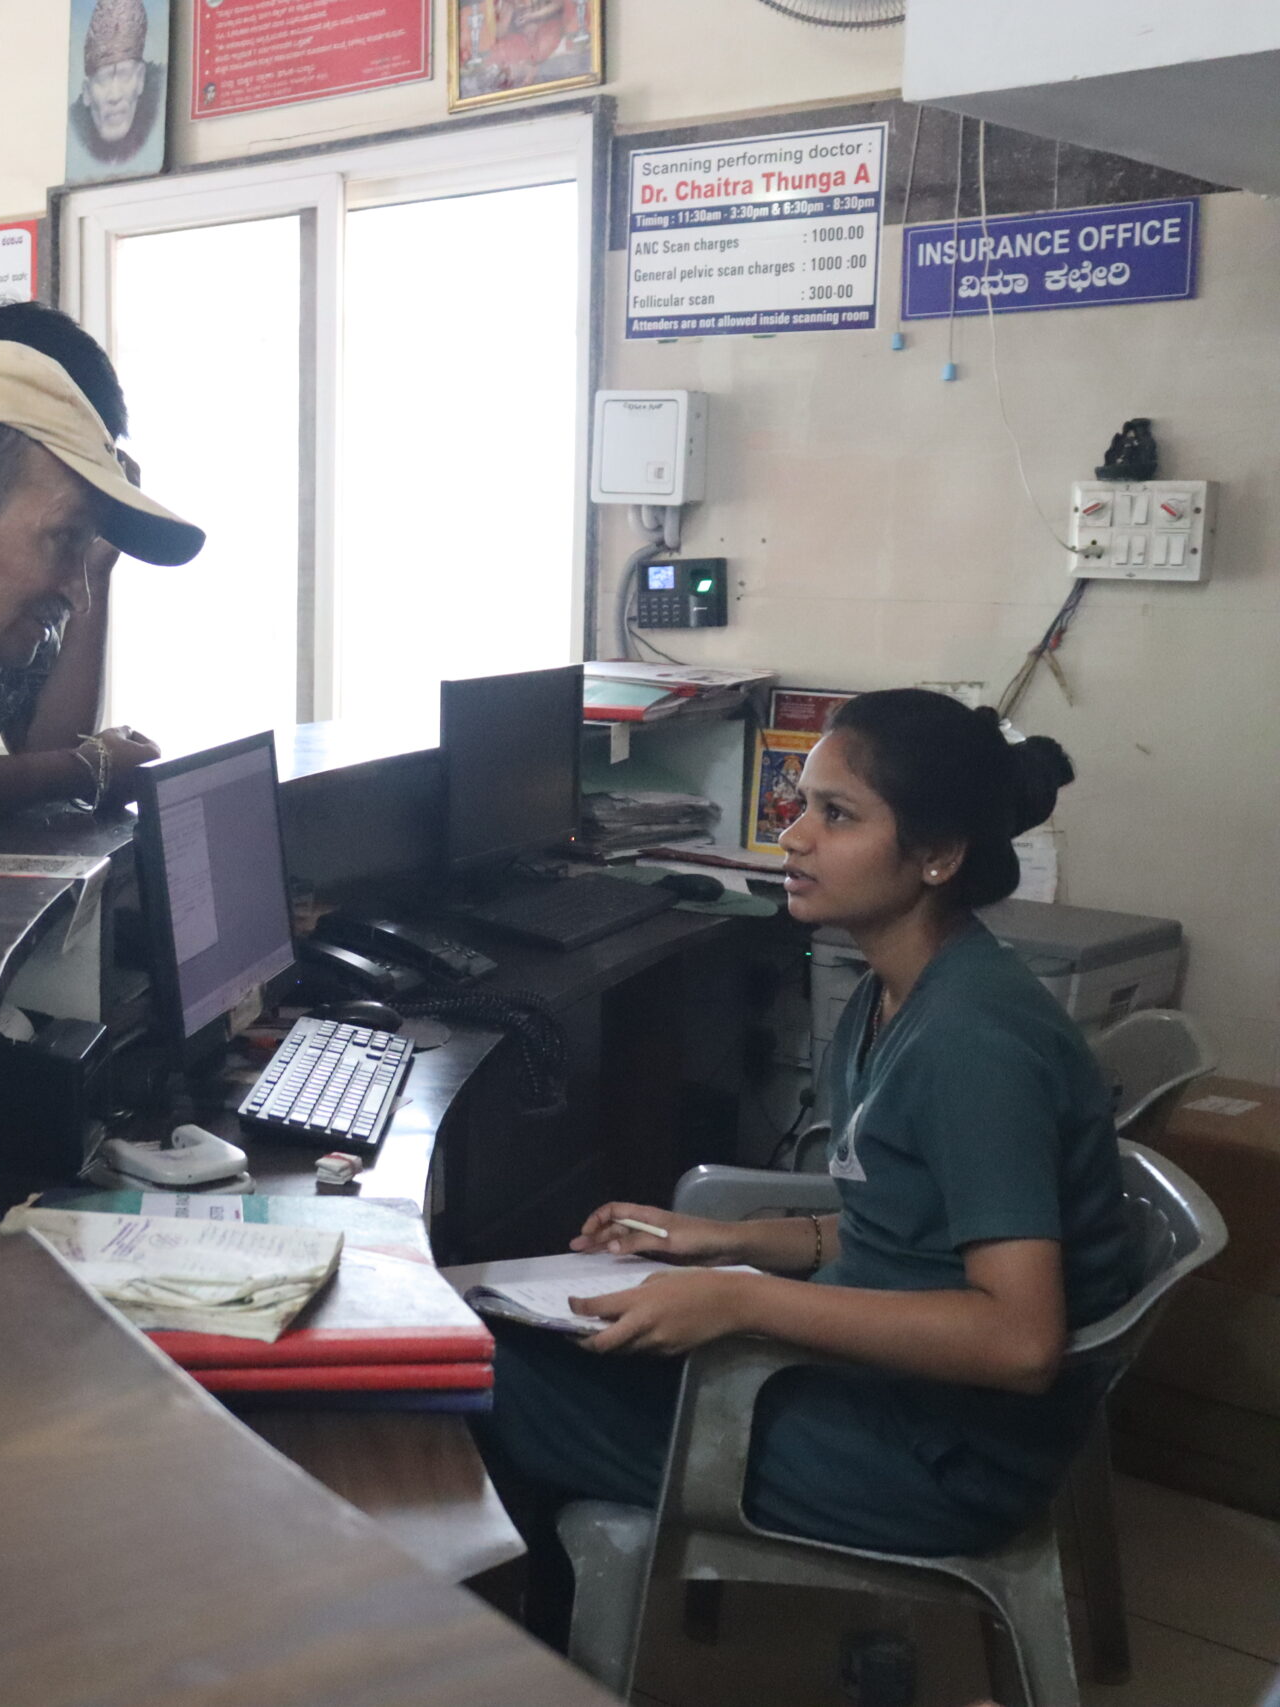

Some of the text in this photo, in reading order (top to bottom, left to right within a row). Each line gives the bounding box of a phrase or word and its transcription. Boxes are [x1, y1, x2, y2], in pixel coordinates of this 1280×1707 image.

[642, 159, 712, 176] Scanning
[717, 148, 803, 171] performing
[809, 143, 863, 159] doctor
[641, 163, 871, 204] Dr. Chaitra Thunga A
[635, 214, 669, 227] Timing
[677, 209, 722, 225] 11:30am
[730, 203, 769, 219] 3:30pm
[771, 202, 781, 216] &
[783, 200, 824, 216] 6:30pm
[833, 196, 875, 211] 8:30pm
[634, 241, 659, 255] ANC
[662, 240, 690, 254] Scan
[694, 237, 740, 252] charges
[812, 225, 864, 242] 1000.00
[918, 218, 1181, 266] INSURANCE OFFICE
[634, 267, 677, 282] General
[680, 264, 714, 282] pelvic
[717, 265, 744, 278] scan
[748, 261, 796, 276] charges
[811, 255, 842, 271] 1000
[958, 261, 1131, 298] ವಿಮಾ ಕಛೇರಿ
[633, 294, 685, 309] Follicular
[688, 294, 715, 306] scan
[632, 310, 869, 332] Attenders are not allowed inside scanning room
